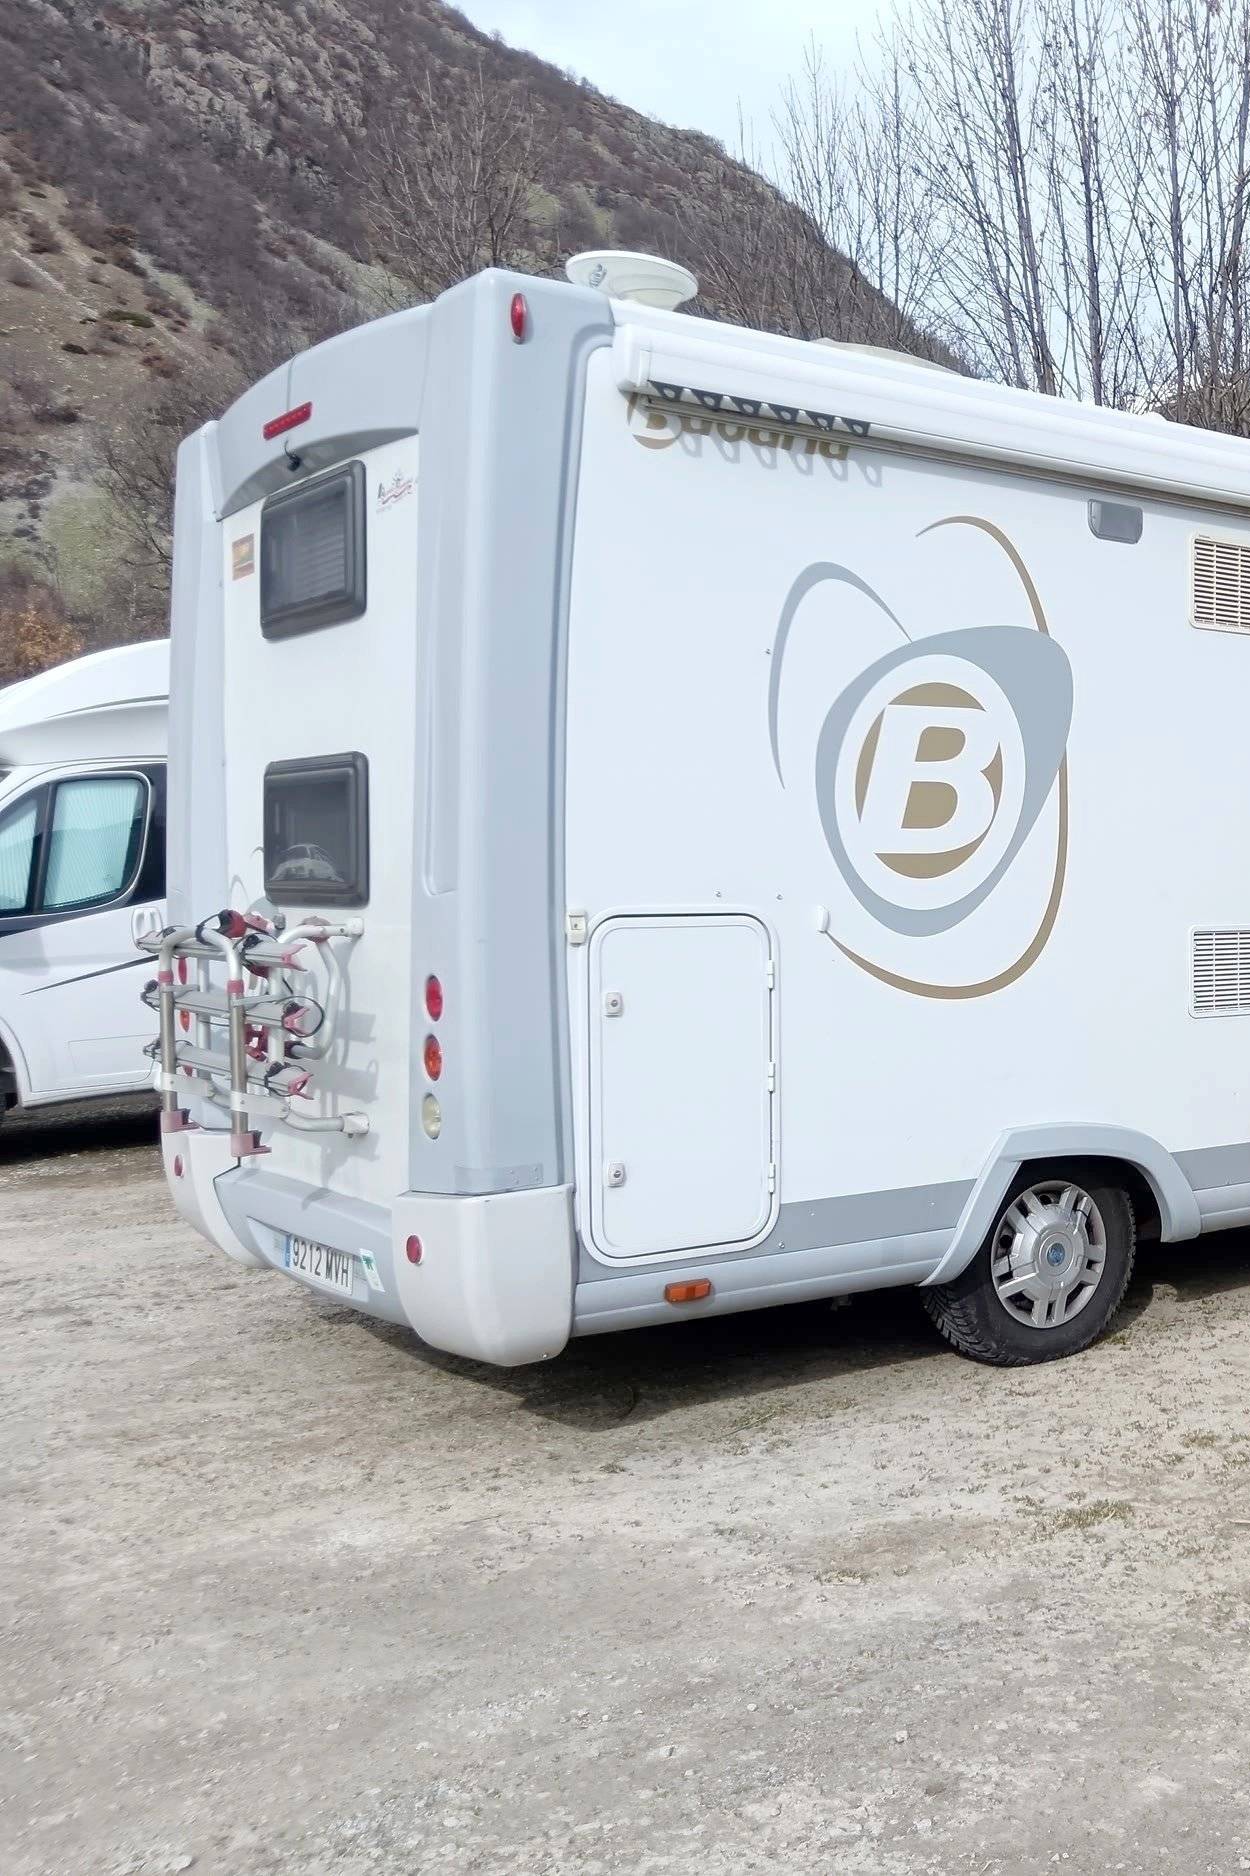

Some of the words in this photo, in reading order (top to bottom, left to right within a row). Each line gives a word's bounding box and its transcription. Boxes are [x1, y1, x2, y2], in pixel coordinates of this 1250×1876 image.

[858, 704, 1000, 855] B
[293, 1238, 321, 1277] 9212
[325, 1247, 350, 1288] MVH
